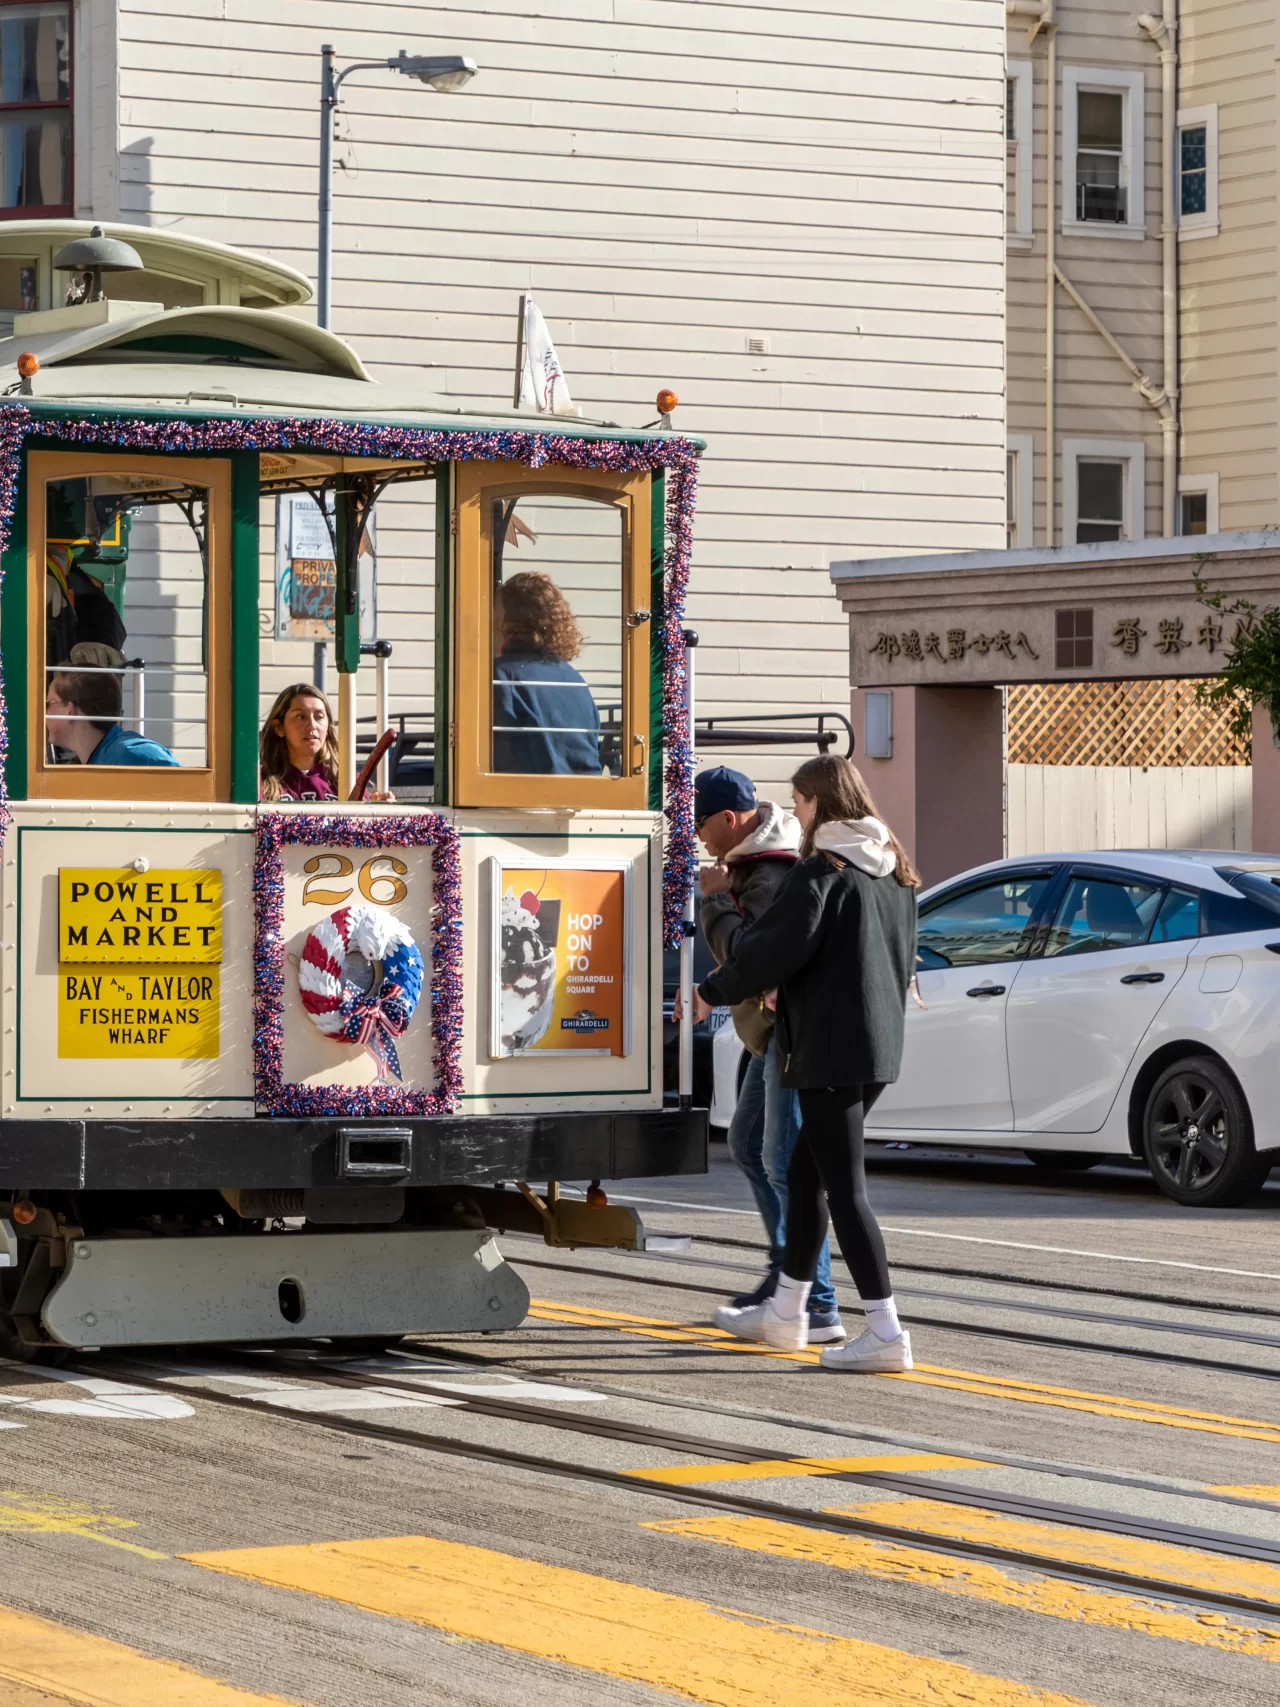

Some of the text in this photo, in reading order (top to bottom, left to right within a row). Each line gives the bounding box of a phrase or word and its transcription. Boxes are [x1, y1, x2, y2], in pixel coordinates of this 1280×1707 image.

[302, 561, 335, 572] PRIVA
[302, 853, 408, 906] 26
[71, 881, 213, 903] POWELL
[109, 907, 178, 922] AND
[567, 913, 603, 931] HOP
[67, 926, 216, 946] MARKET
[566, 934, 592, 951] ON
[566, 955, 589, 972] TO
[566, 975, 614, 983] GHIRARDELLI
[66, 976, 213, 1001] BAY AND TAYLOR
[566, 986, 595, 994] SQUARE
[79, 1008, 199, 1025] FISHERMANS
[562, 1020, 608, 1028] GHIRARDELLI
[108, 1028, 170, 1044] WHARF
